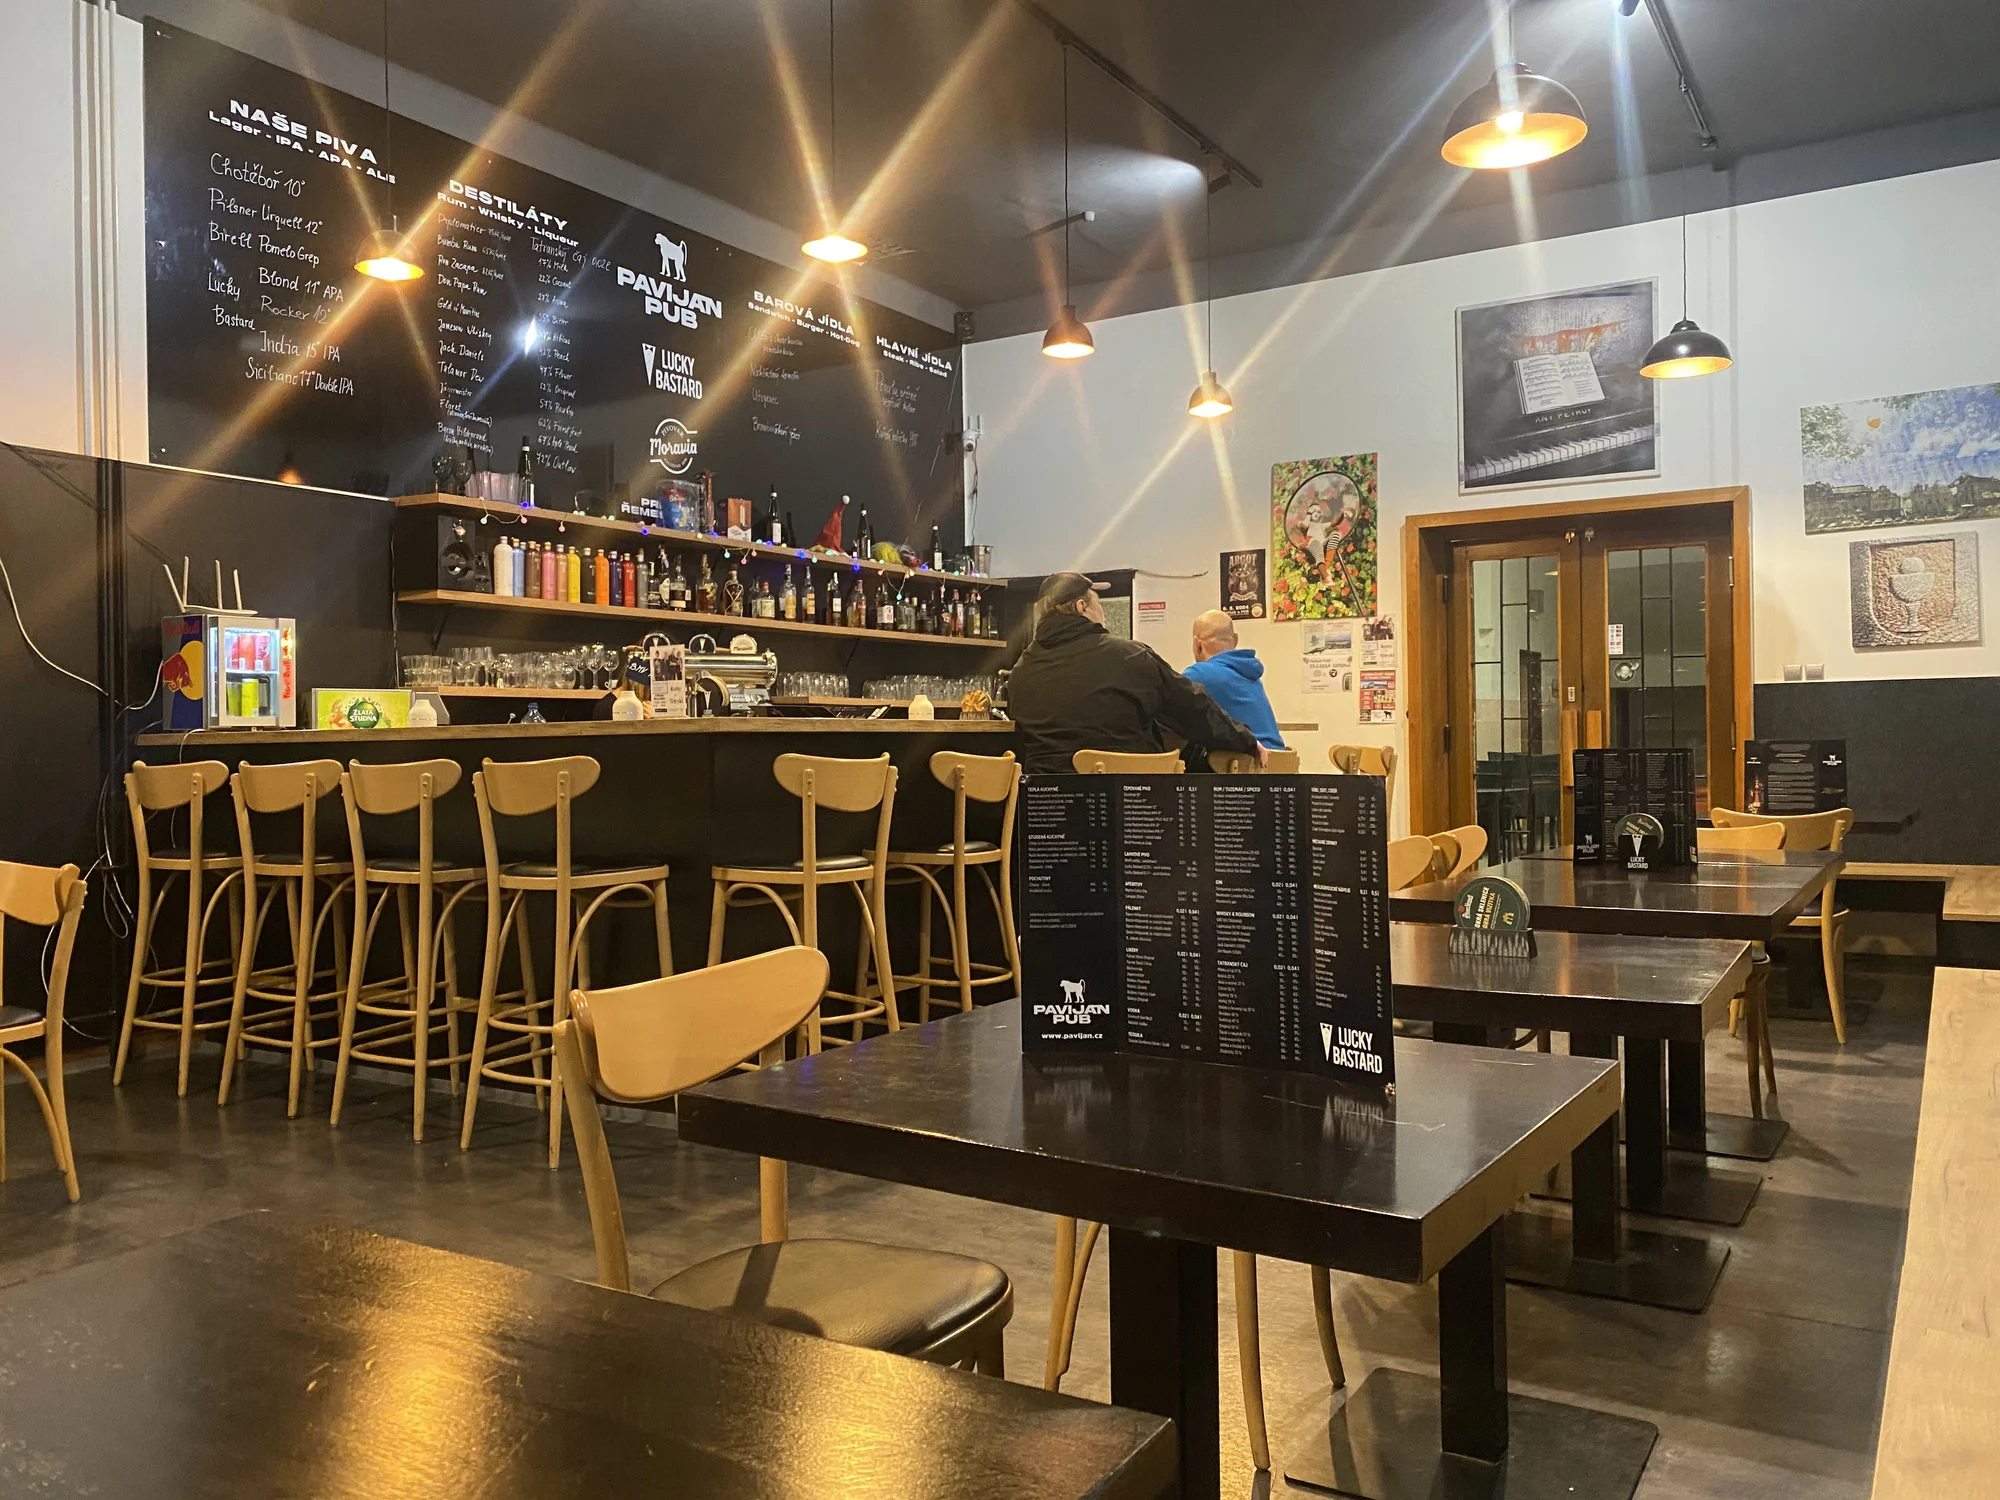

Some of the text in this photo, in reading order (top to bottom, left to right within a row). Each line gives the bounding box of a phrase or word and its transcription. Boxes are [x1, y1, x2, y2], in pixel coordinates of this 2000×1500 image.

[208, 110, 262, 136] Lager
[275, 135, 304, 152] IPA
[318, 150, 353, 169] APA
[230, 99, 378, 165] NAŠE PIVA
[210, 152, 283, 190] Chotěboř
[208, 187, 324, 235] Pilsner Urquell 12°
[437, 191, 467, 209] Rum
[478, 205, 524, 230] Whisky
[534, 225, 580, 248] Liqueur
[449, 179, 568, 231] DESTILÁTY
[258, 234, 296, 259] Pomelo
[297, 246, 320, 269] Grep
[208, 272, 241, 301] Lucky
[258, 267, 300, 291] Blond
[323, 285, 344, 302] APA
[617, 266, 722, 319] PAVIJAN
[212, 304, 256, 330] Bastard
[260, 295, 310, 320] Rocker
[645, 296, 698, 329] PUB
[753, 290, 855, 336] BAROVÁ JÍDLA
[747, 301, 861, 348] Sandwich Burger Hot-Dog
[259, 330, 301, 357] India
[323, 345, 341, 363] IPA
[661, 349, 695, 376] LUCKY
[876, 335, 953, 371] HLAVNÍ JÍDLA
[883, 350, 905, 364] Steak
[928, 366, 948, 378] Salad
[655, 369, 703, 400] BASTARD
[650, 438, 698, 456] Moravia
[1229, 553, 1257, 569] ARGOT
[1033, 1004, 1110, 1015] PAVIJAN
[1052, 1014, 1092, 1025] PUB
[1041, 1032, 1104, 1040] www.pavijan.cz
[1338, 1026, 1373, 1051] LUCKY
[1332, 1046, 1383, 1074] BASTARD
